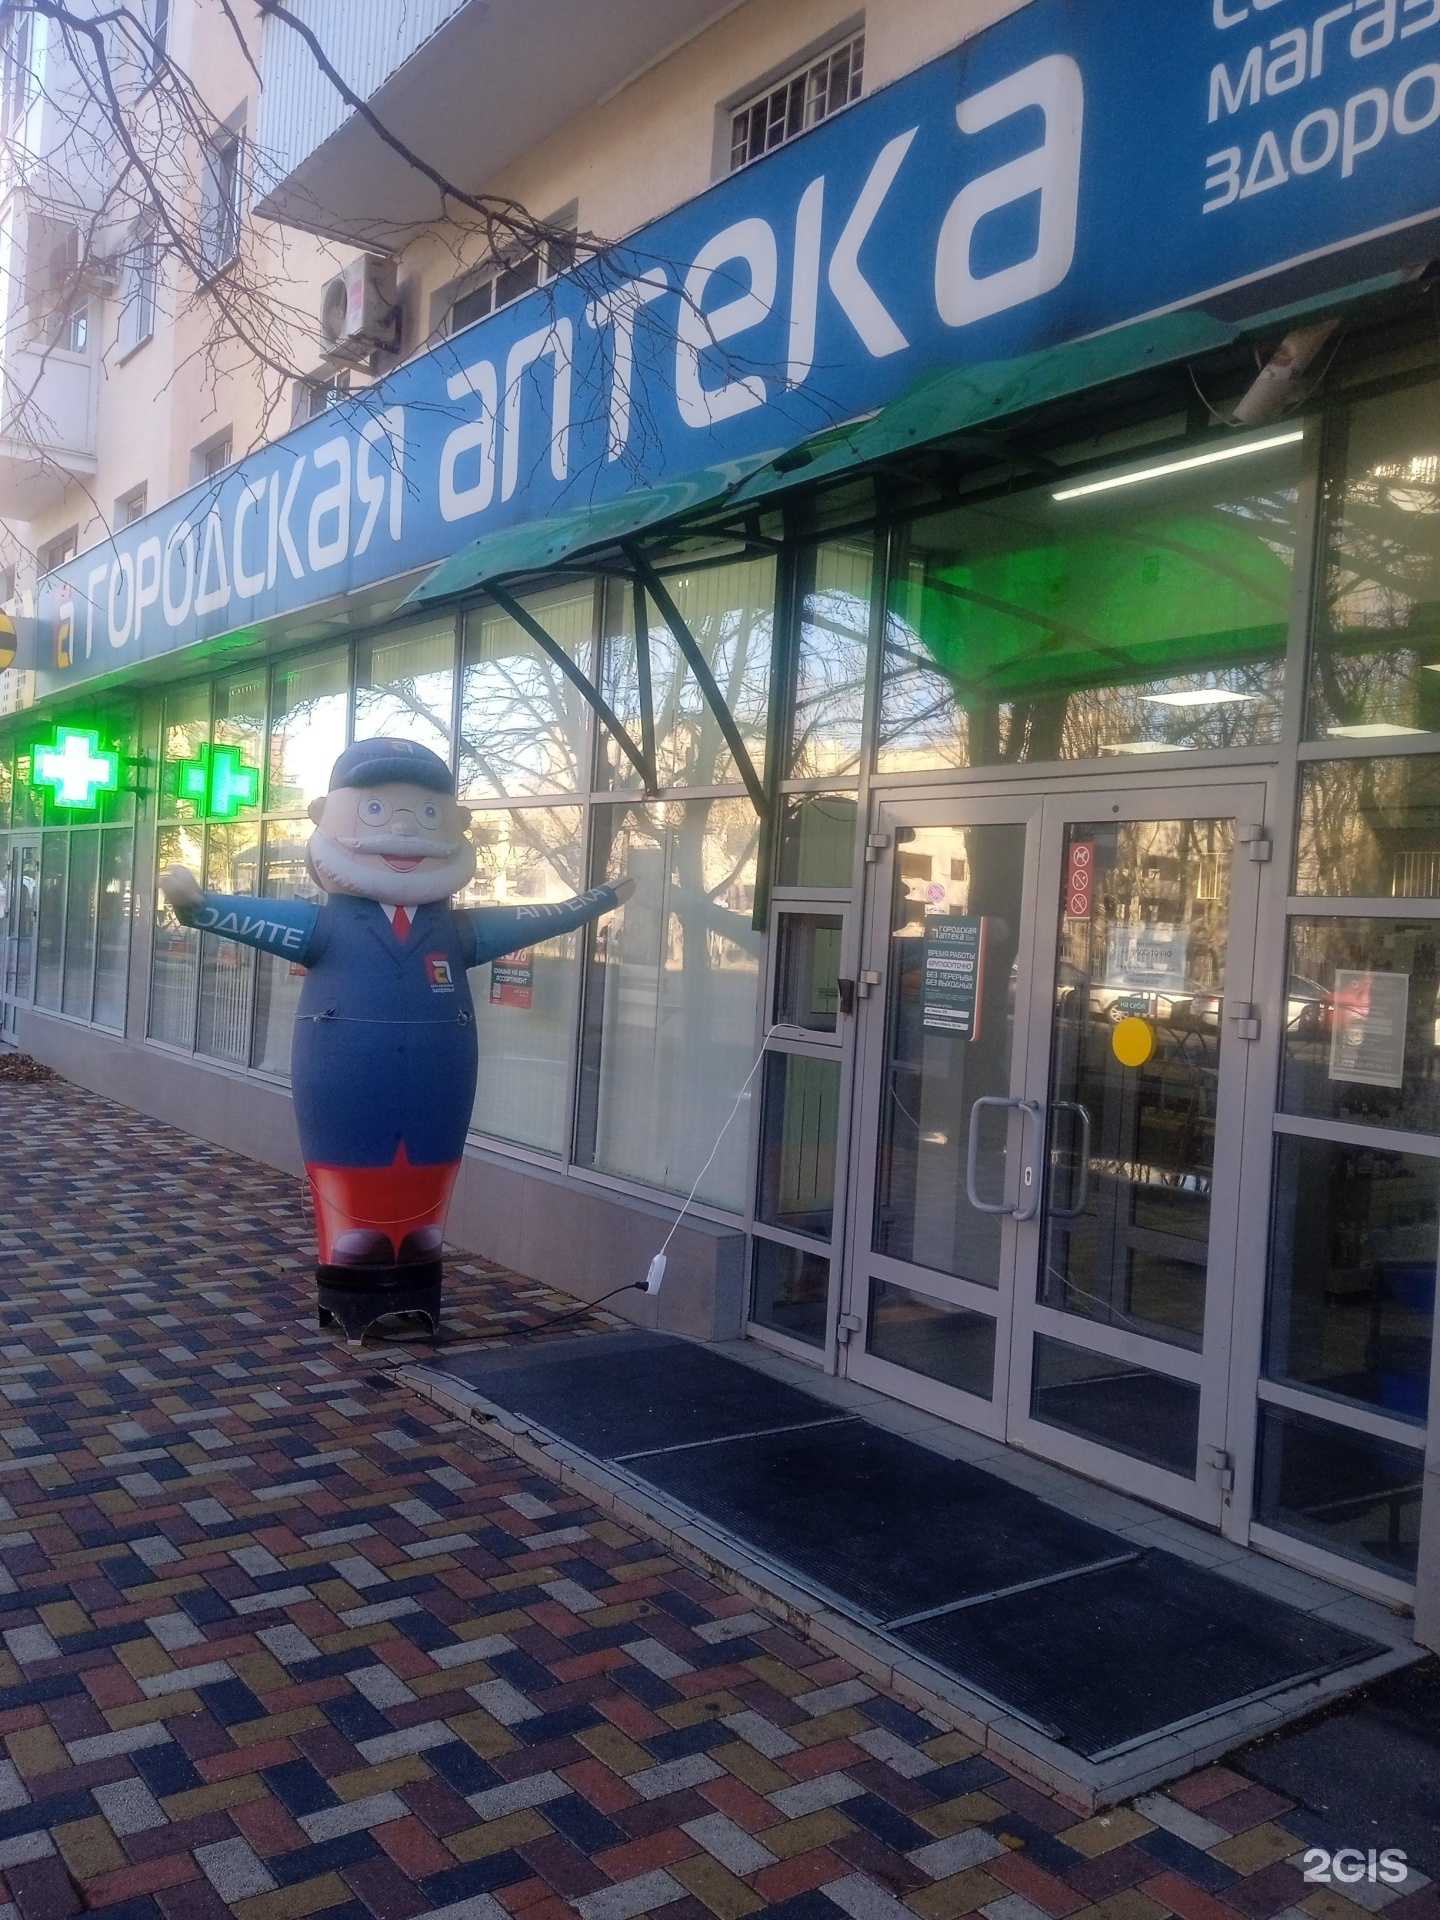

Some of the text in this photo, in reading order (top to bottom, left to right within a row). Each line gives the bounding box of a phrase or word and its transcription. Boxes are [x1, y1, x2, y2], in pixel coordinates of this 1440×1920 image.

[927, 949, 977, 960] ВРЕМЯ РАБОТЫ
[940, 972, 973, 982] ПЕРЕРЫВА
[925, 978, 973, 989] БЕЗ ВЫХОДНЫХ
